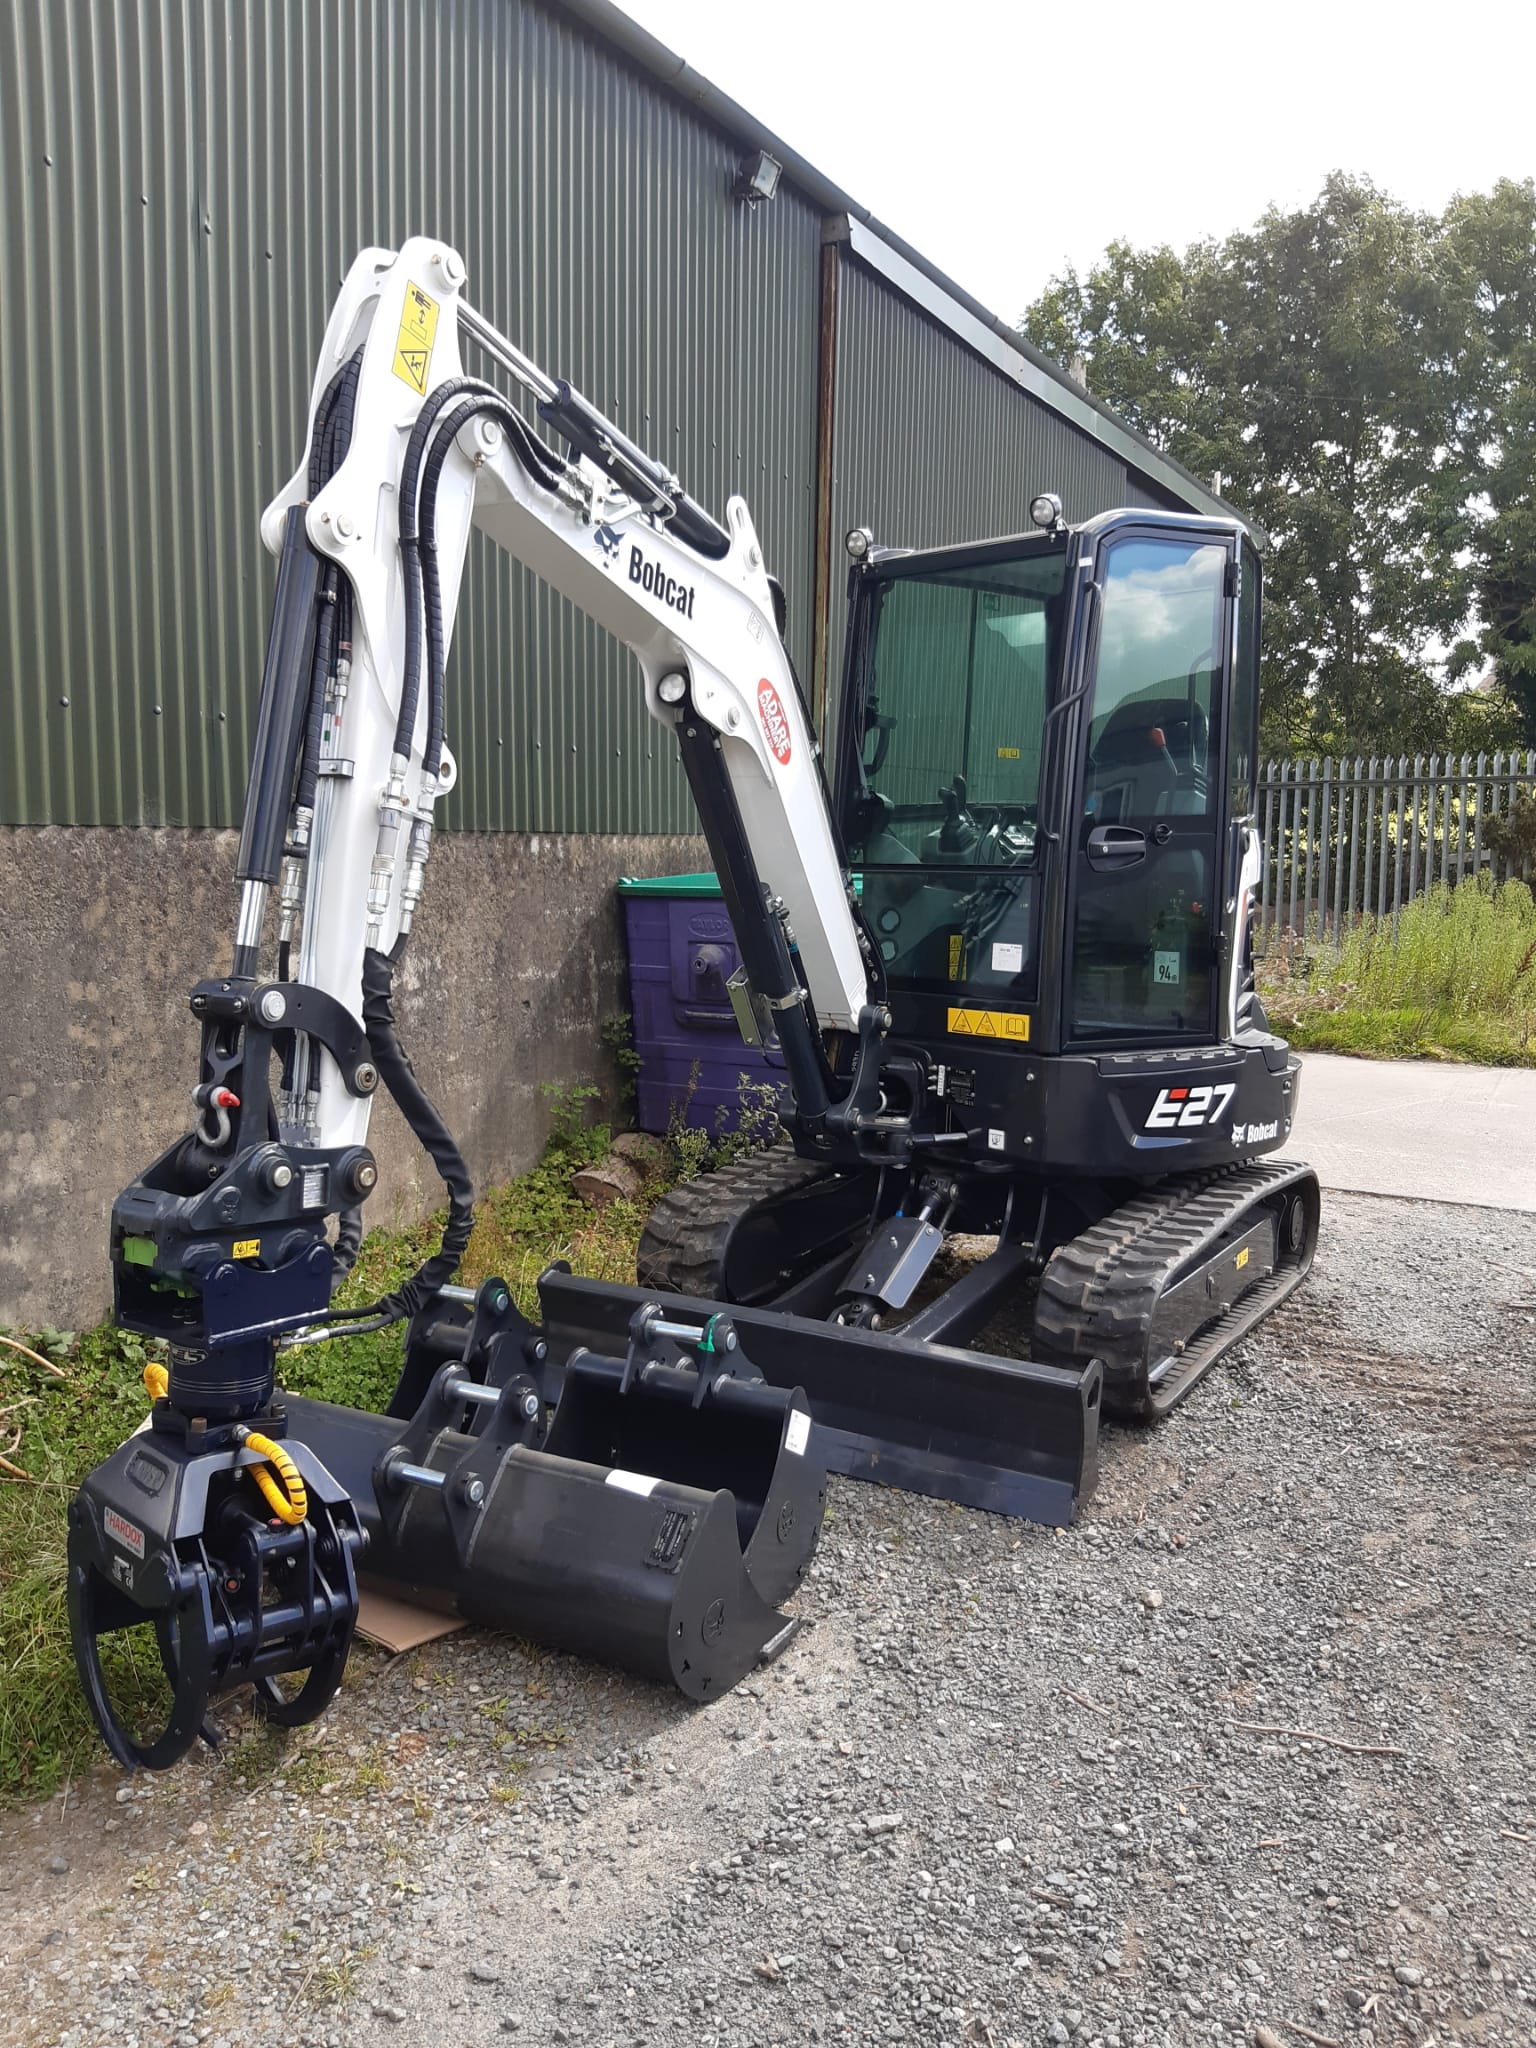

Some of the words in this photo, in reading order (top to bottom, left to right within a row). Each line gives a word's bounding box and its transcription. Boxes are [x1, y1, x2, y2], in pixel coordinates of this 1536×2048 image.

[628, 544, 696, 620] Bobcat
[762, 689, 791, 755] ADARE
[1158, 964, 1171, 981] 94
[1144, 1082, 1237, 1129] E27
[1247, 1119, 1278, 1144] Bobcat
[109, 1513, 143, 1547] HARDOX
